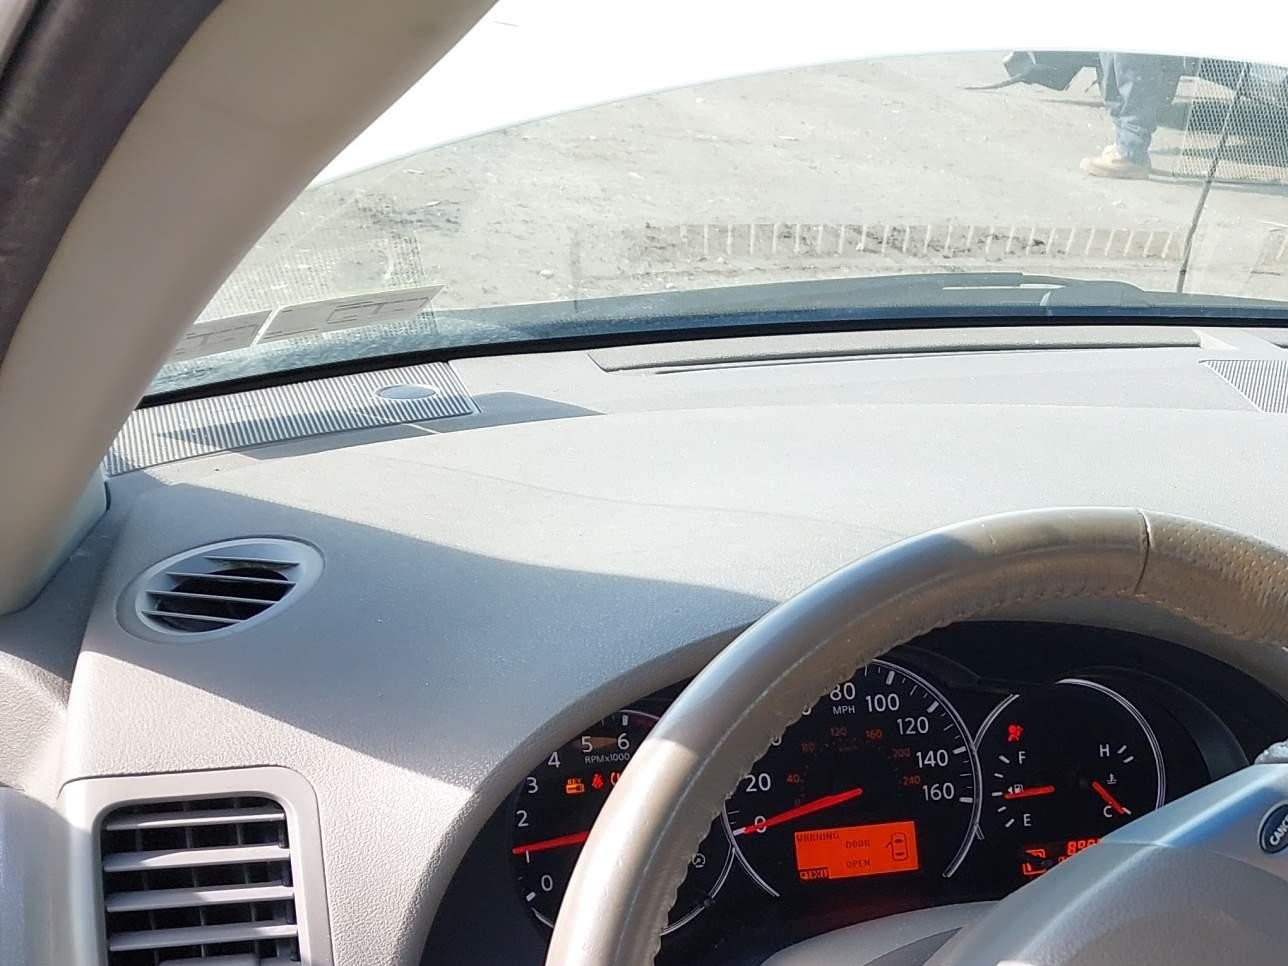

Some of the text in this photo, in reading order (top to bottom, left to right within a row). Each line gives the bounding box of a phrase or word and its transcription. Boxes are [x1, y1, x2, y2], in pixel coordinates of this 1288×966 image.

[833, 705, 855, 715] MPH
[865, 693, 900, 712] 100
[897, 716, 929, 735] 120
[581, 736, 593, 753] 5
[617, 732, 630, 750] 6
[1018, 751, 1026, 764] F
[1099, 743, 1110, 757] H
[547, 751, 561, 768] 4
[916, 750, 949, 769] 140
[526, 776, 539, 794] 3
[745, 773, 772, 792] 20
[922, 782, 955, 801] 160
[516, 810, 529, 827] 2
[1023, 813, 1031, 827] E
[1103, 805, 1113, 818] C
[754, 815, 767, 833] 0
[846, 859, 871, 868] OPEN
[541, 875, 553, 891] 0
